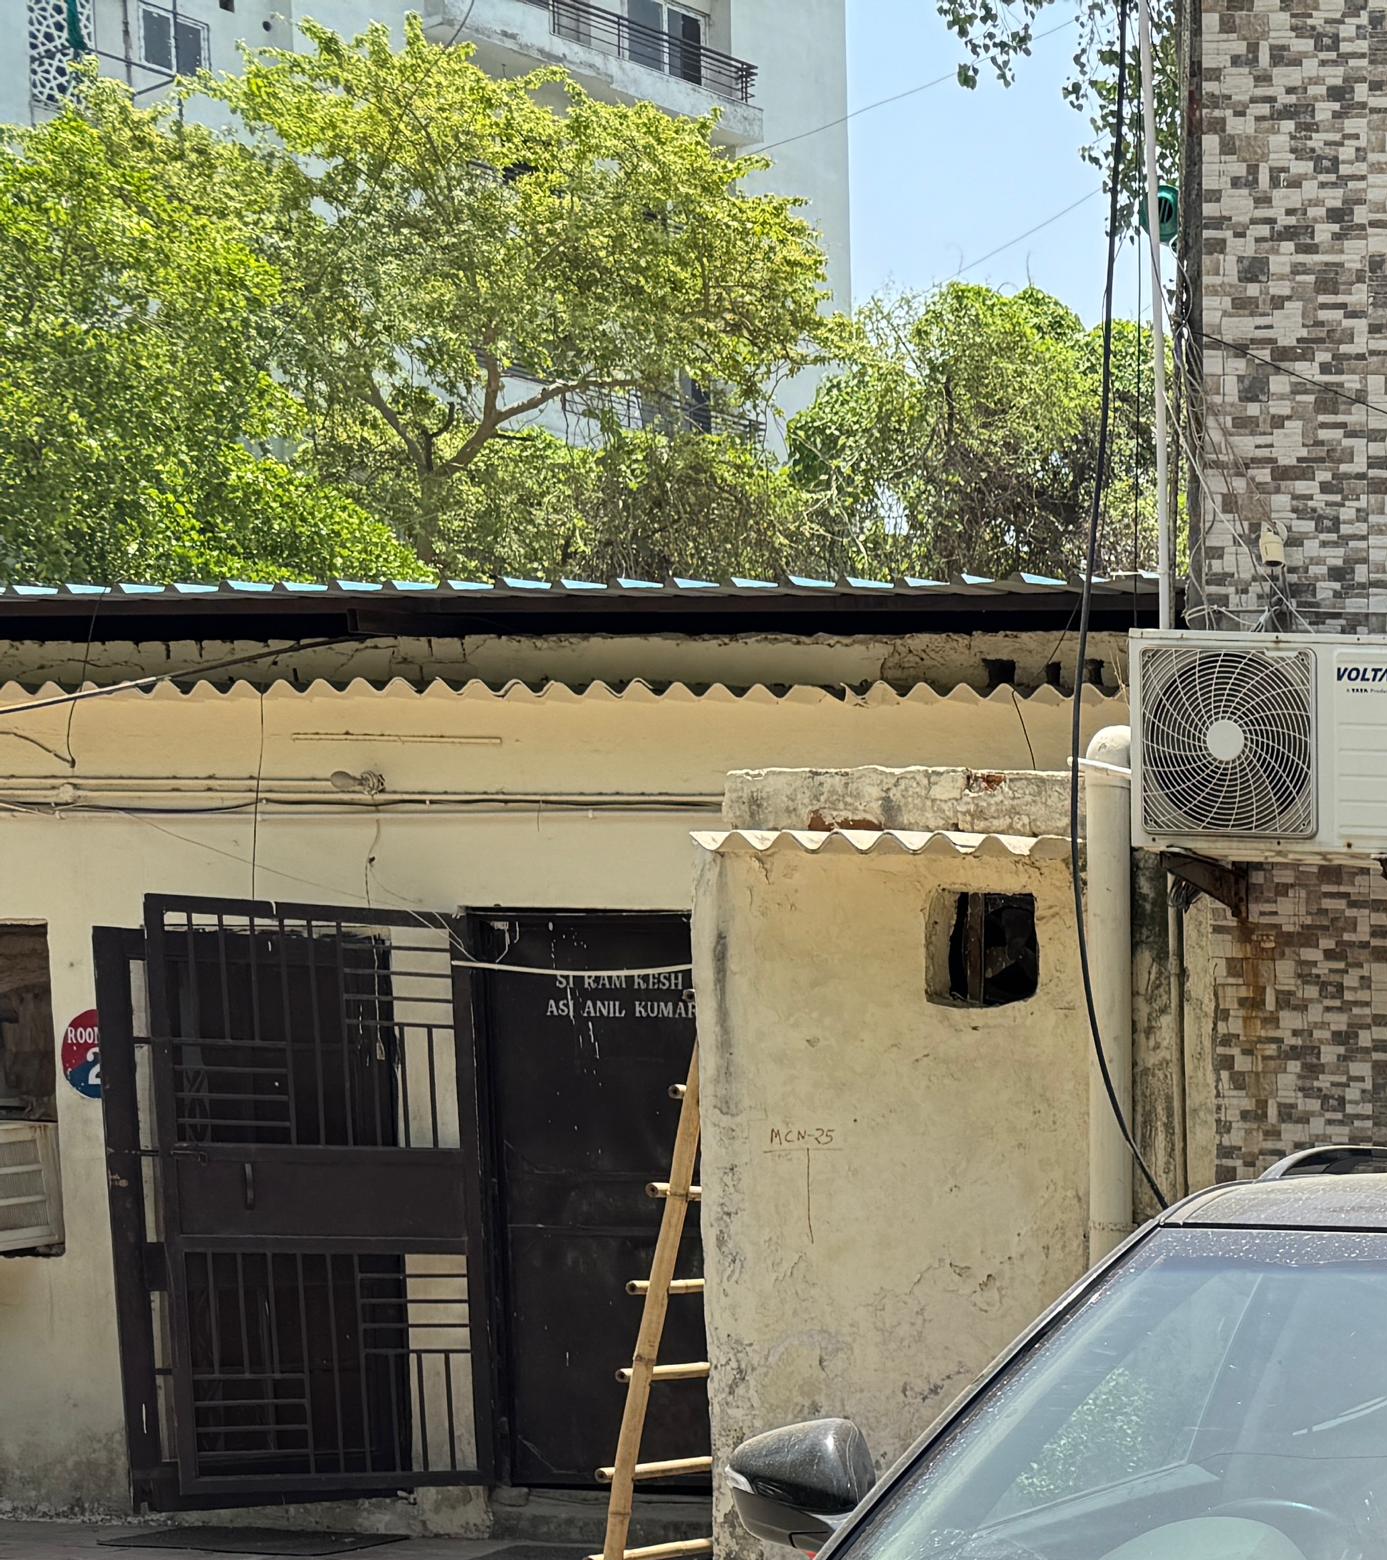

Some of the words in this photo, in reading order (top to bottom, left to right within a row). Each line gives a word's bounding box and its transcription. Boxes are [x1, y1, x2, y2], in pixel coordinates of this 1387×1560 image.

[584, 974, 626, 989] RAM
[633, 973, 683, 990] KESH
[546, 999, 574, 1016] ASI
[583, 1000, 626, 1017] ANIL
